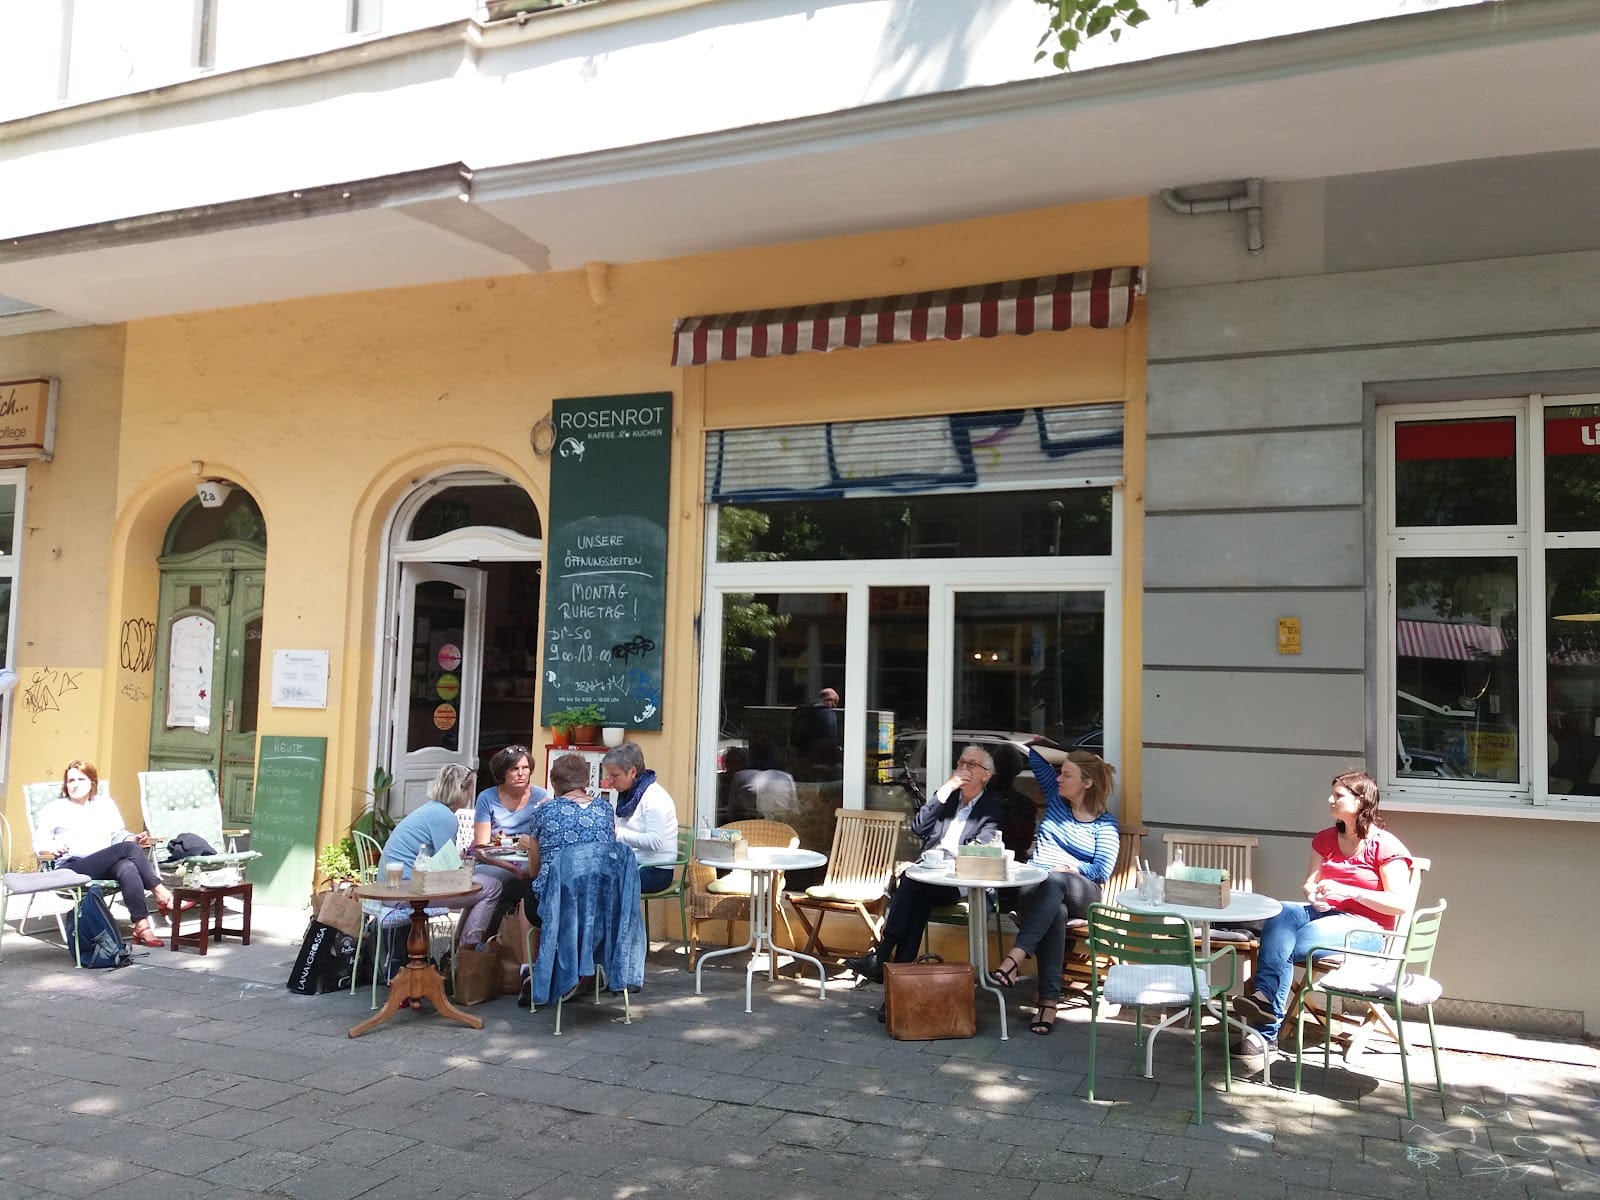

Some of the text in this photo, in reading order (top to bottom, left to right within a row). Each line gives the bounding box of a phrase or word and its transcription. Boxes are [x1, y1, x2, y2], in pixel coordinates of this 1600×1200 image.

[560, 407, 665, 429] ROSENROT
[587, 431, 616, 440] KAFFEE
[632, 428, 663, 439] KUCHEN
[200, 490, 216, 502] 2a
[577, 534, 625, 550] UNSERE
[564, 549, 643, 568] ÖFFNUNGSZEITEN
[572, 582, 629, 602] MONTAG
[558, 602, 625, 620] RUHETAG
[274, 739, 304, 753] HEUTE
[297, 966, 311, 990] LANA
